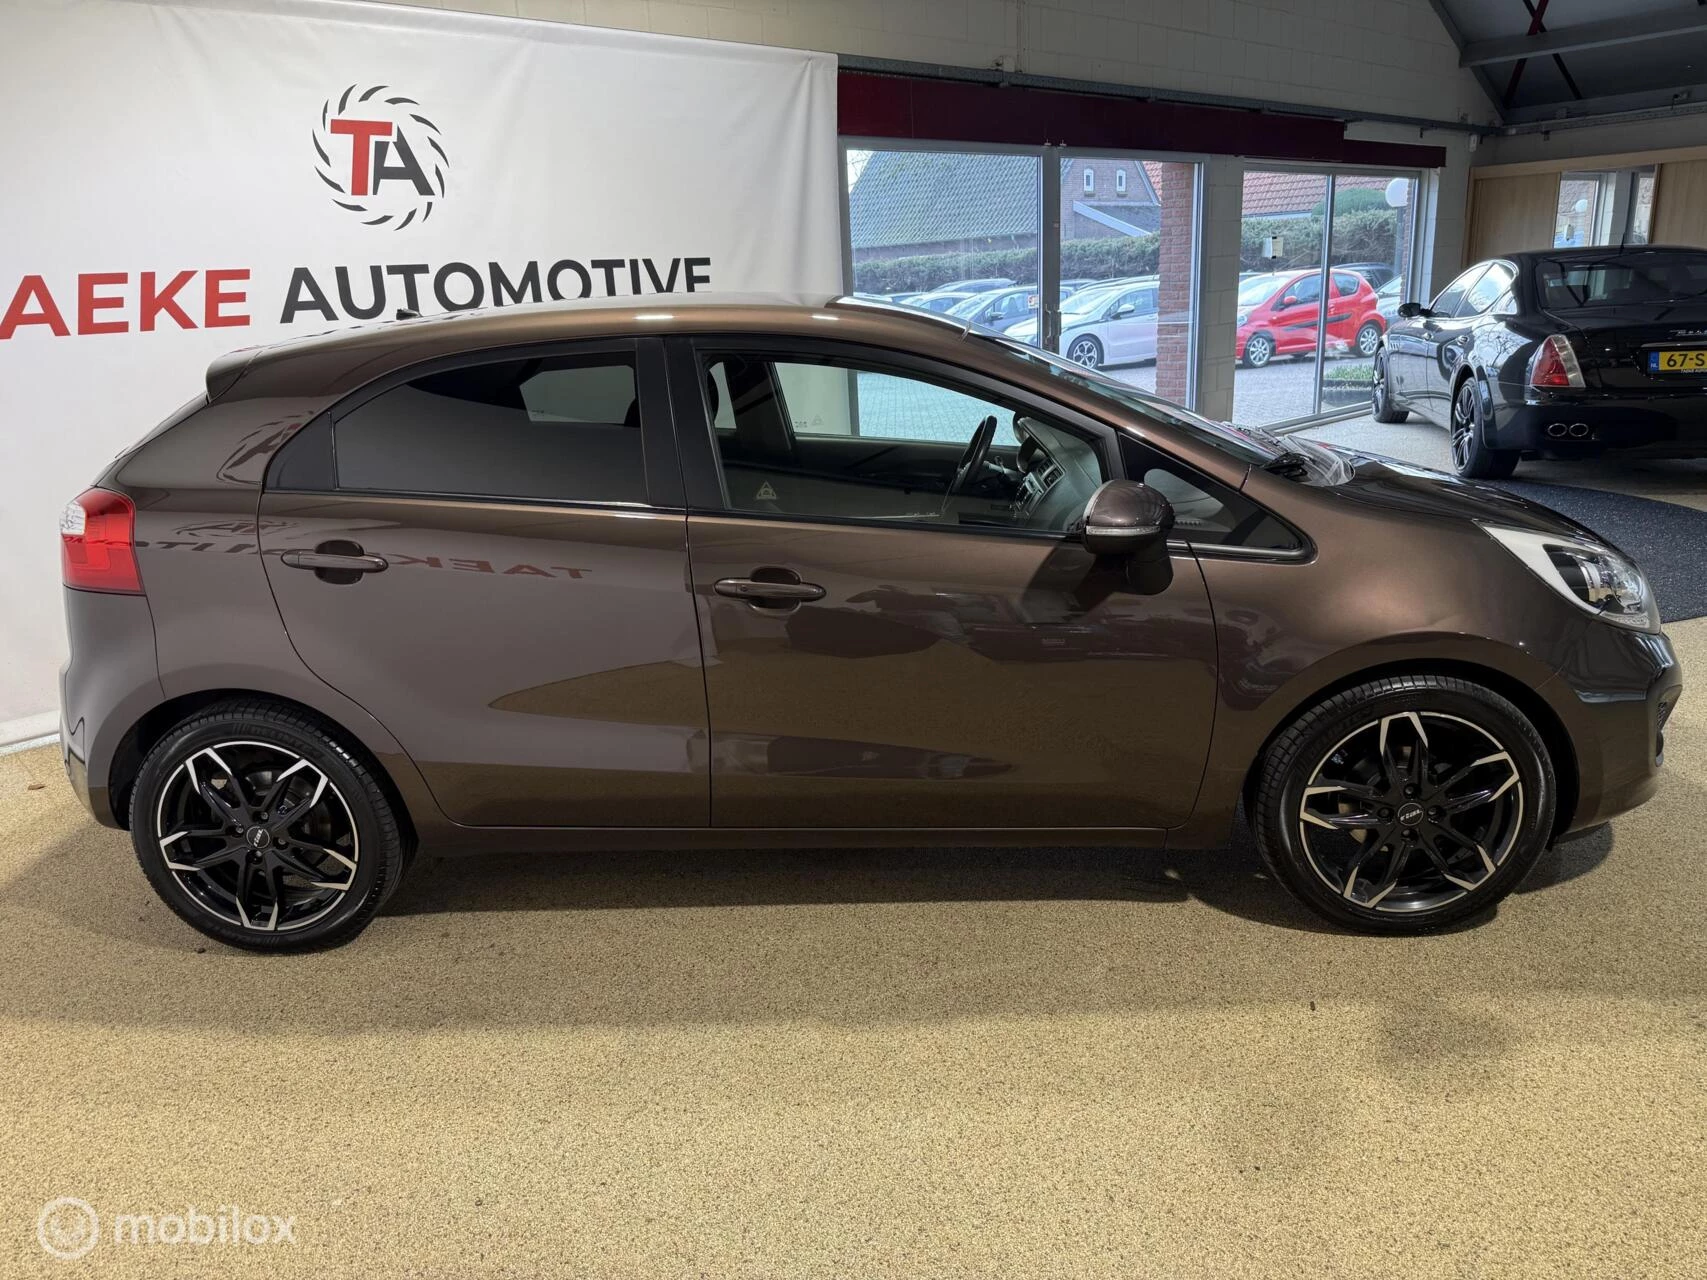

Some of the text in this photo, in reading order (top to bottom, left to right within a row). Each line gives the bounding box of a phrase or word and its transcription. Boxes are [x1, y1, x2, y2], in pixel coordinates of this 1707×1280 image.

[331, 119, 435, 196] TA
[0, 257, 711, 339] AEKE AUTOMOTIVE
[1666, 353, 1705, 368] 67-S
